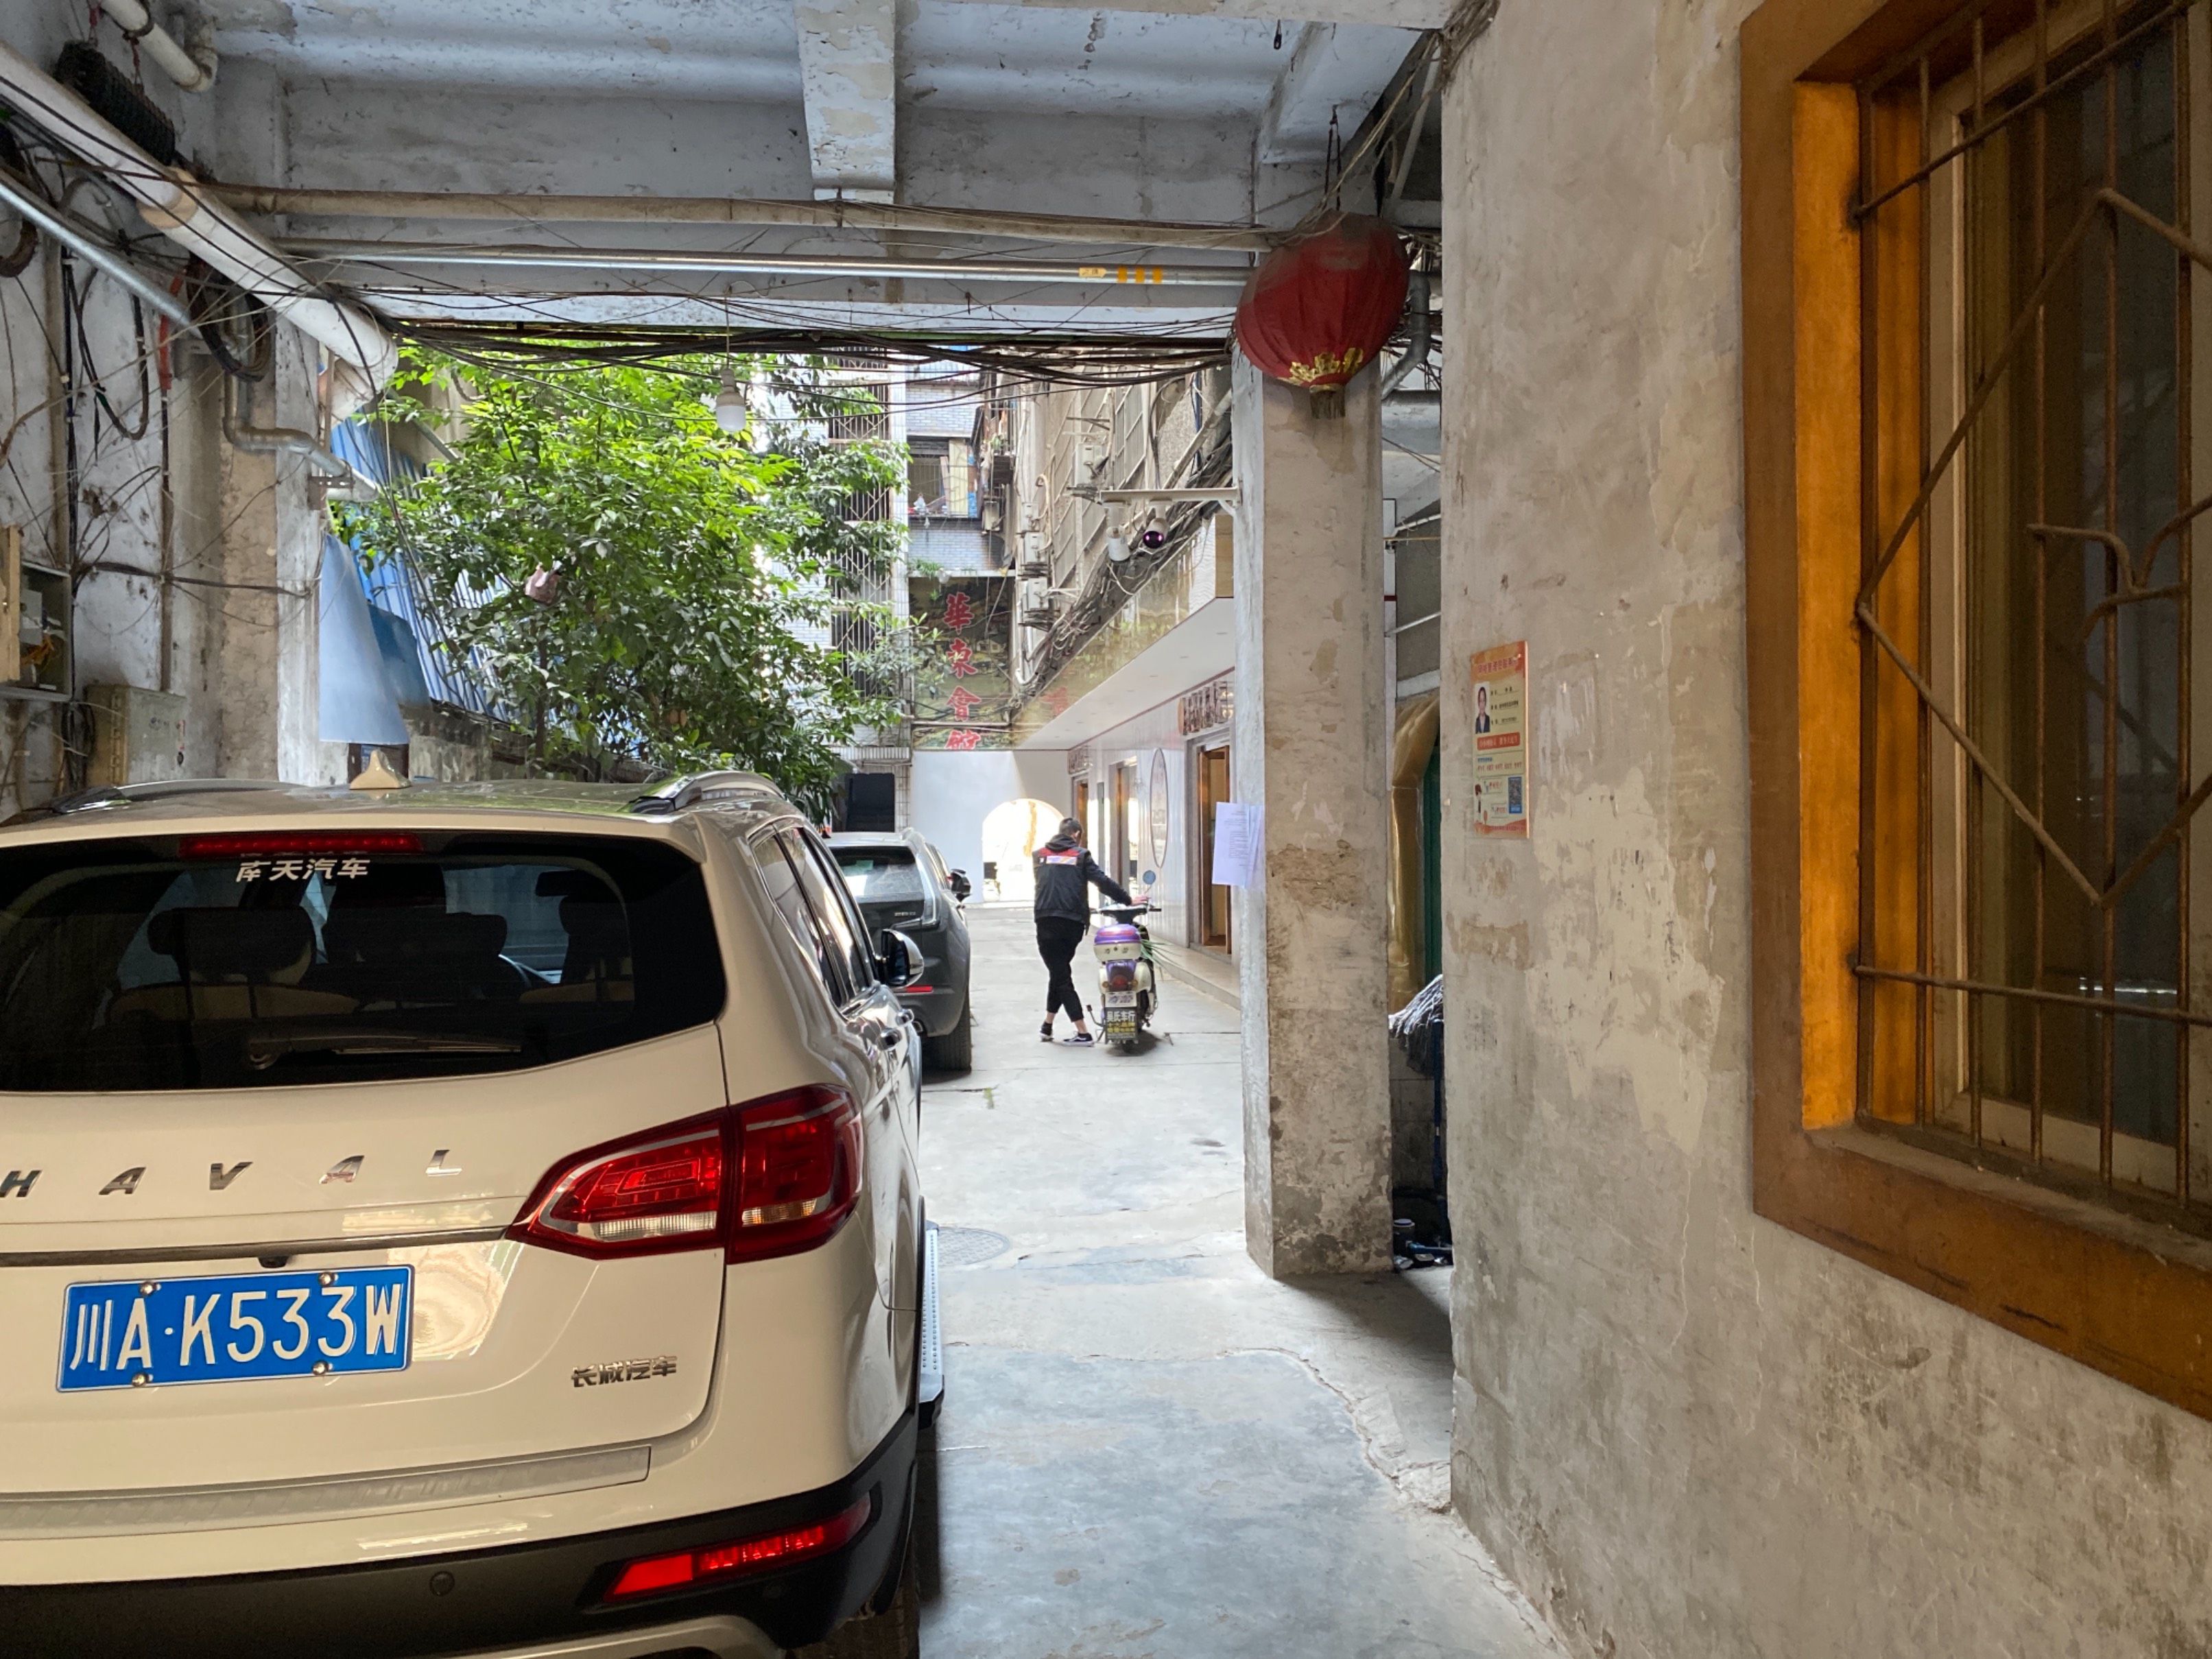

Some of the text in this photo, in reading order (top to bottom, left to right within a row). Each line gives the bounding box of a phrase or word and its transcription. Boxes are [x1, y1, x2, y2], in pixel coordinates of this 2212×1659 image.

[235, 857, 371, 883] 南天汽车
[0, 1148, 462, 1198] HAVAL
[69, 1282, 403, 1372] 川A·K533W
[571, 1355, 678, 1388] 长城汽车
